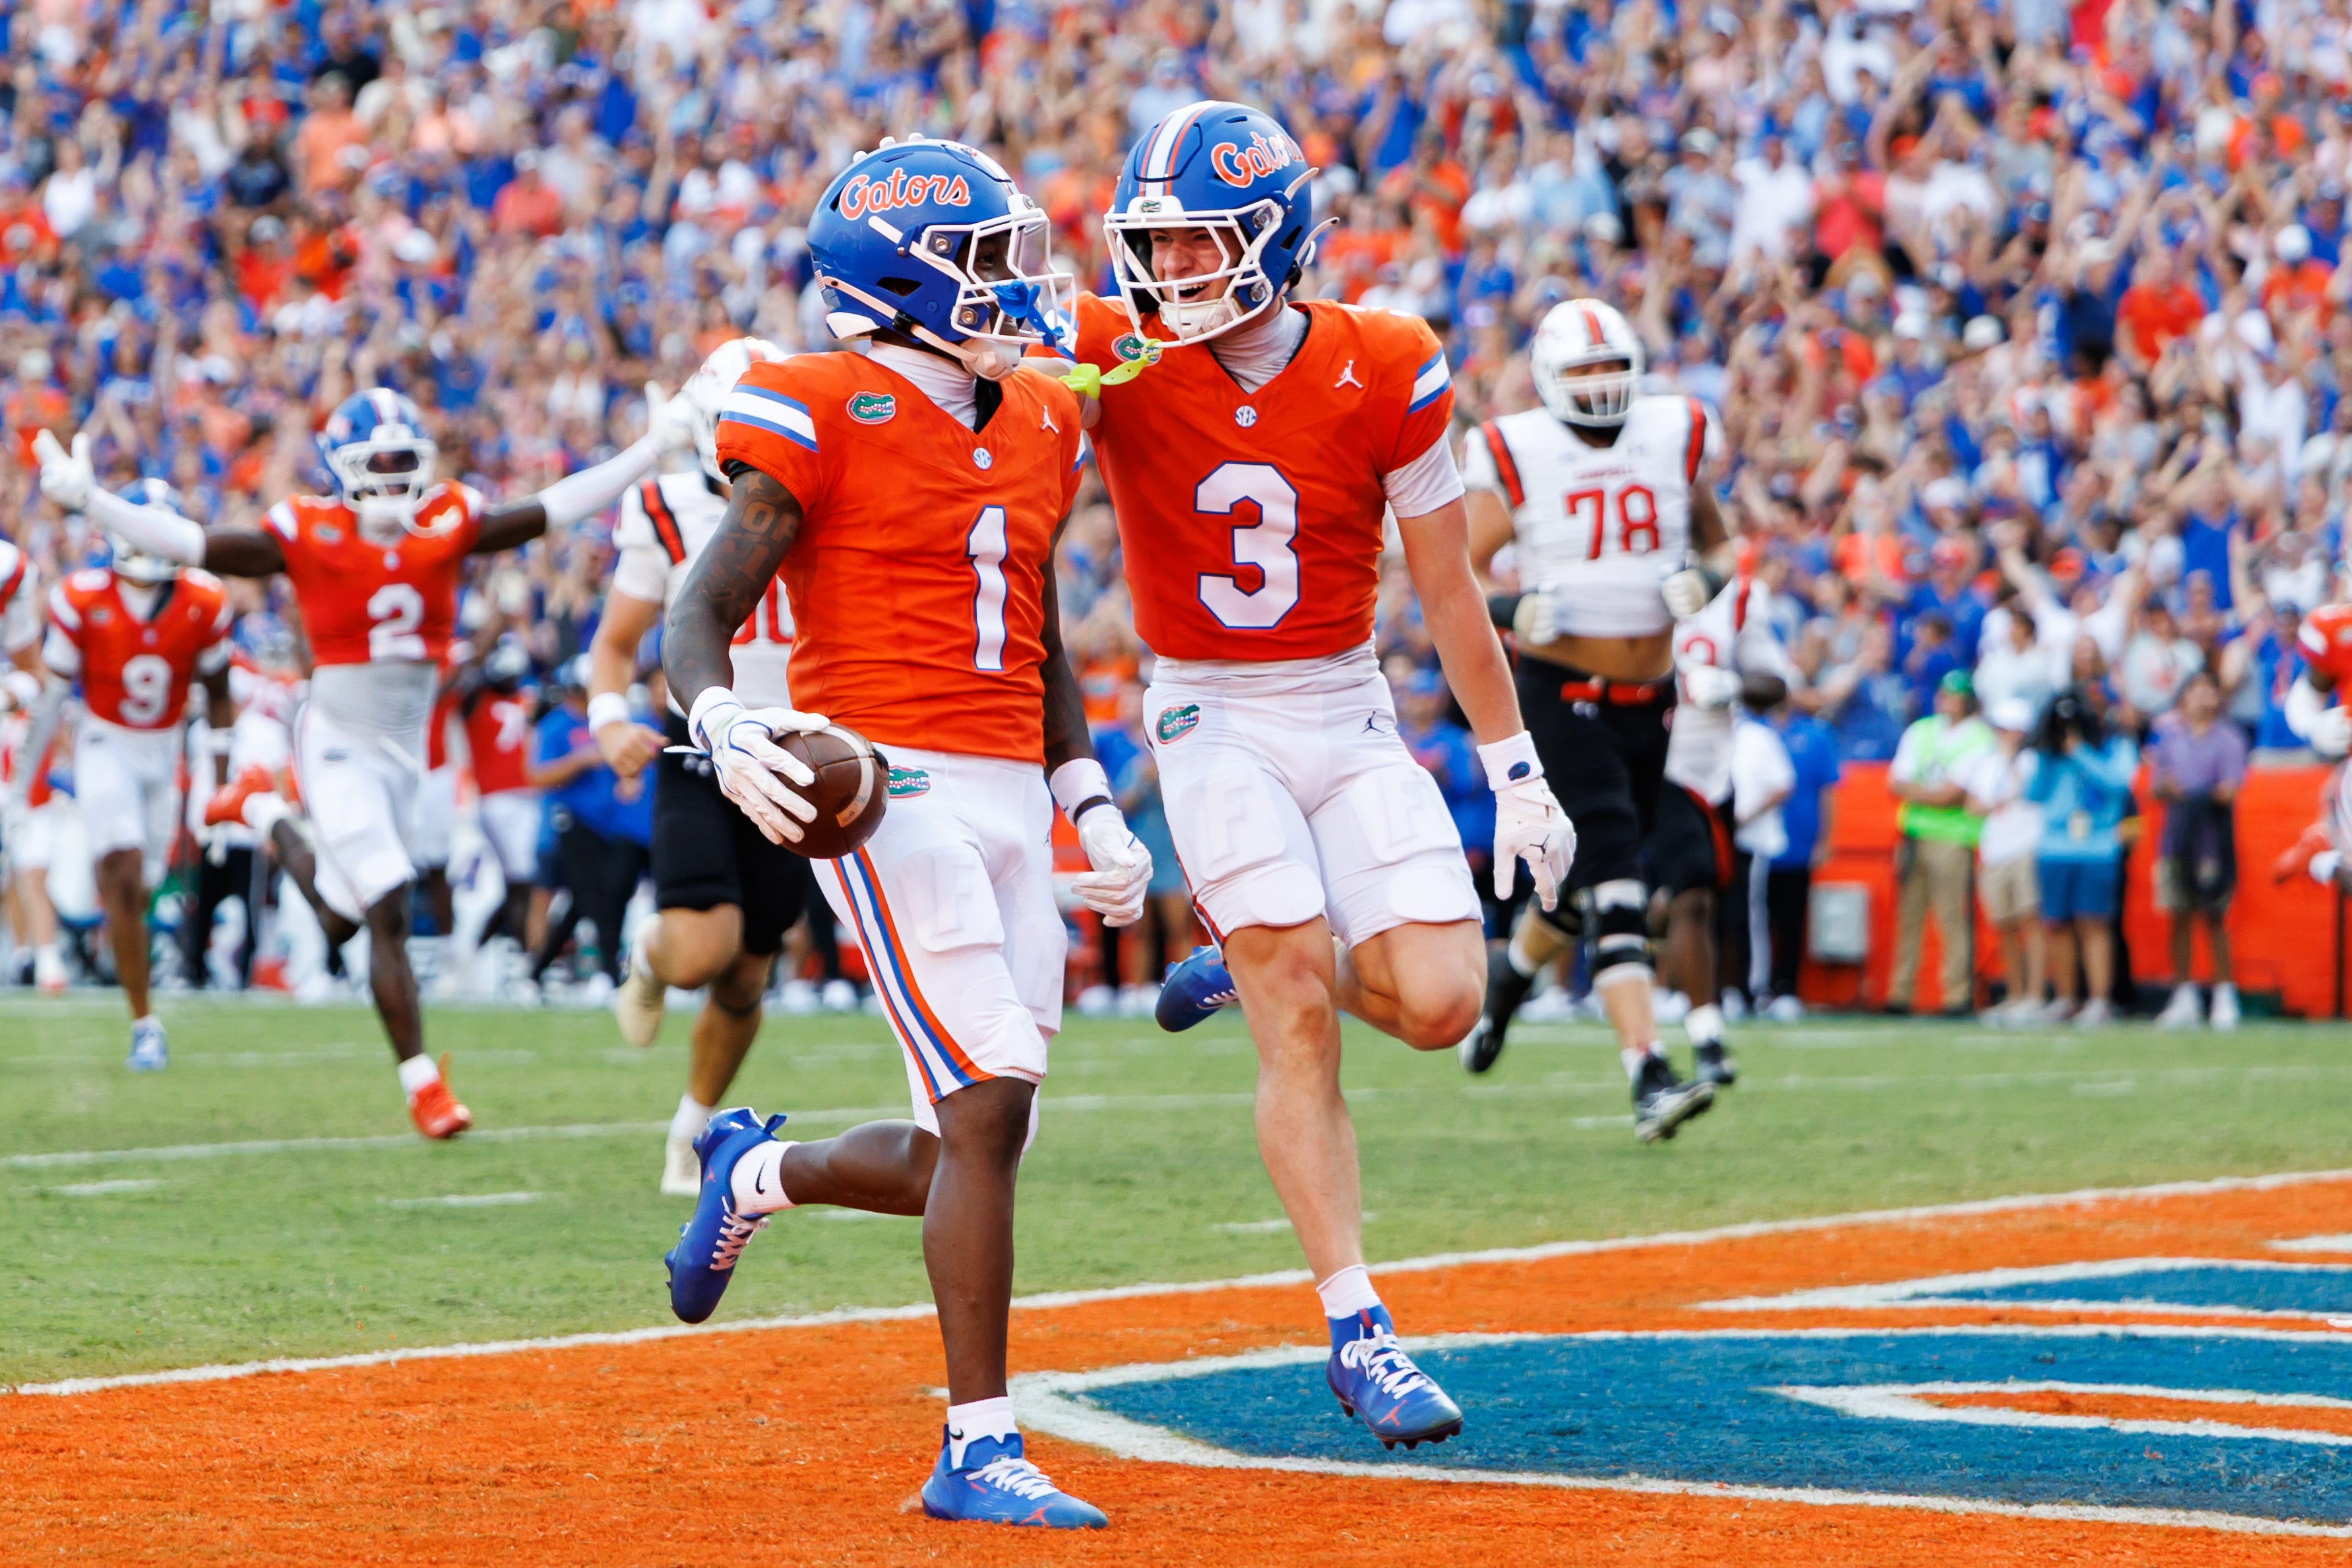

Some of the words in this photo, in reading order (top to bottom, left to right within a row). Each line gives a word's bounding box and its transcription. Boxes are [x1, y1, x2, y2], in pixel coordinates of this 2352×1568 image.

[839, 167, 971, 221] Gators
[1235, 405, 1257, 427] SEC
[973, 447, 993, 469] SEC
[1193, 460, 1300, 630] 3
[1563, 483, 1660, 560] 78
[367, 582, 428, 660] 2
[965, 504, 1008, 672] 1
[117, 653, 172, 725] 9
